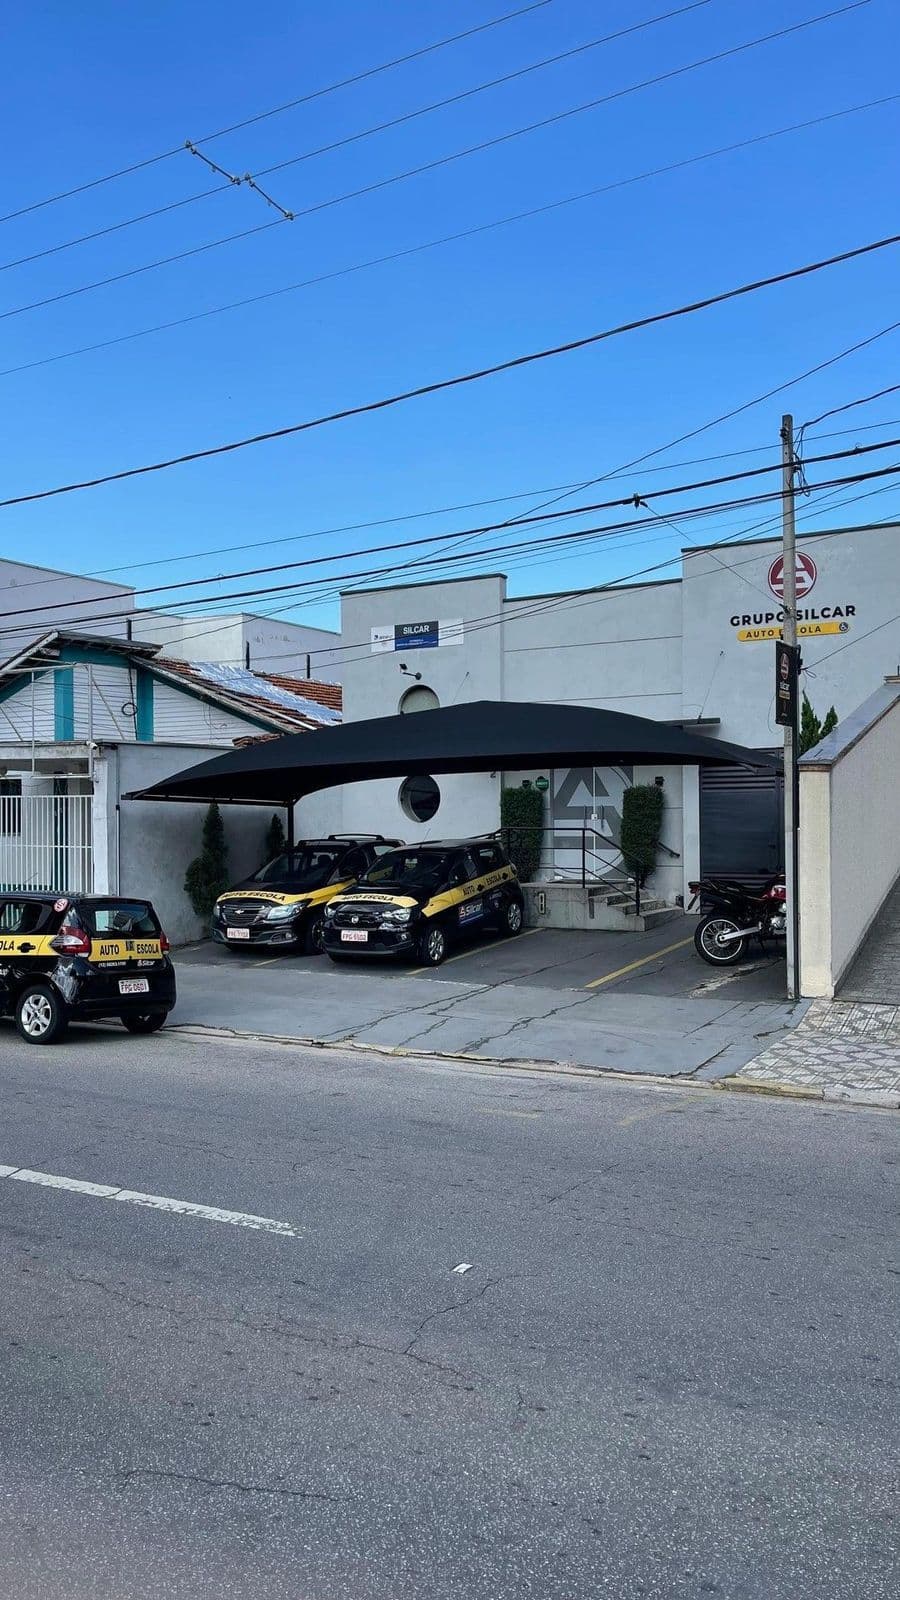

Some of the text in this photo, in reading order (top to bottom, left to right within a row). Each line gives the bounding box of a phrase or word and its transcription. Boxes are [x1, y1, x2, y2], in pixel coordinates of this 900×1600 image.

[730, 605, 856, 627] GRUPO SILCAR
[403, 624, 430, 635] SILCAR
[745, 625, 822, 639] AUTO EOLA
[462, 874, 501, 896] AUTO ESCOLA
[222, 891, 286, 902] AUTO ESCOLA
[362, 894, 394, 902] ESCOLA
[100, 943, 159, 956] AUTO ESCOLA
